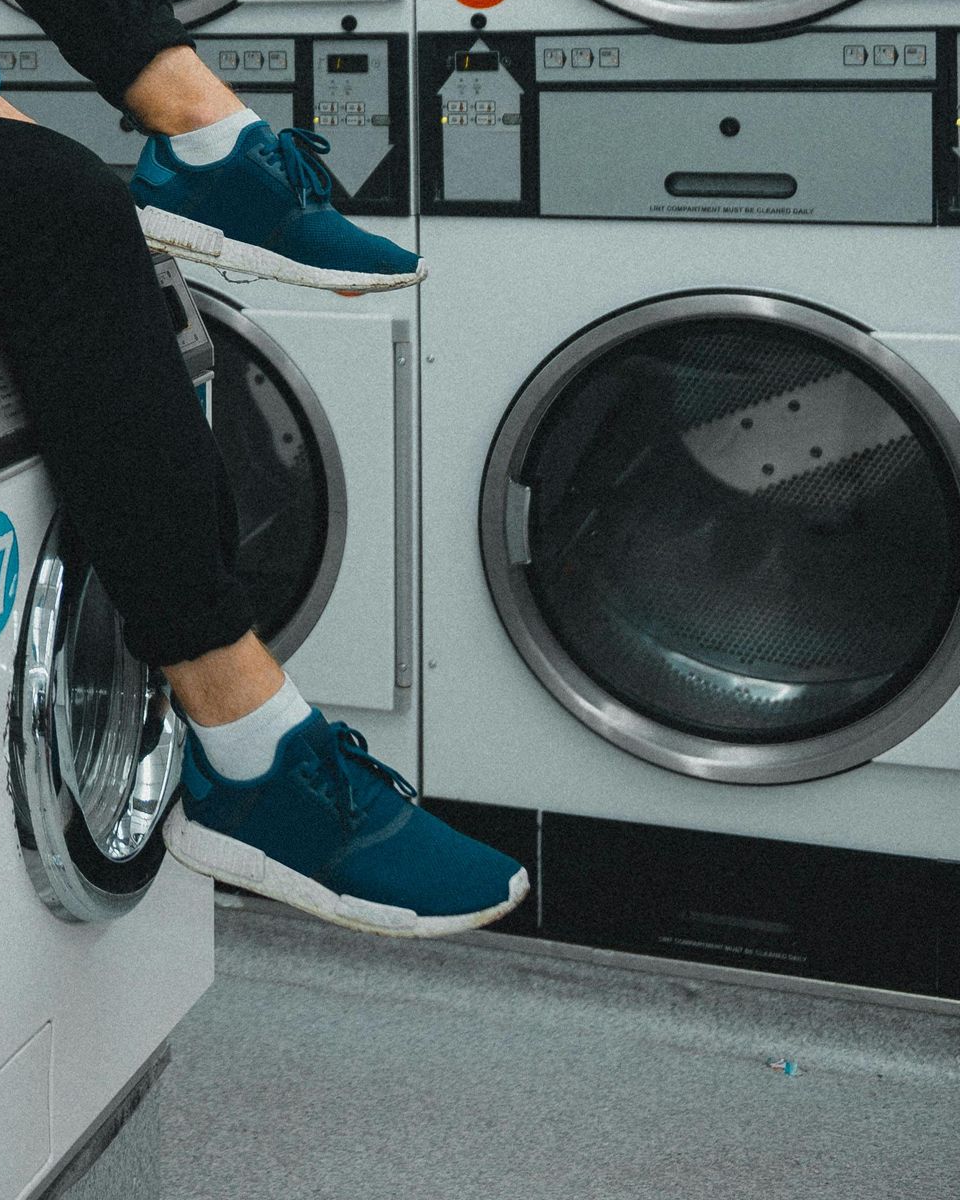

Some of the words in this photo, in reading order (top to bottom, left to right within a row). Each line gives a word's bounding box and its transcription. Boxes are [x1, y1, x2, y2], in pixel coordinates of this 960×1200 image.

[666, 205, 721, 213] COMPARTMENT
[722, 206, 743, 214] MUST
[756, 207, 791, 215] CLEANED
